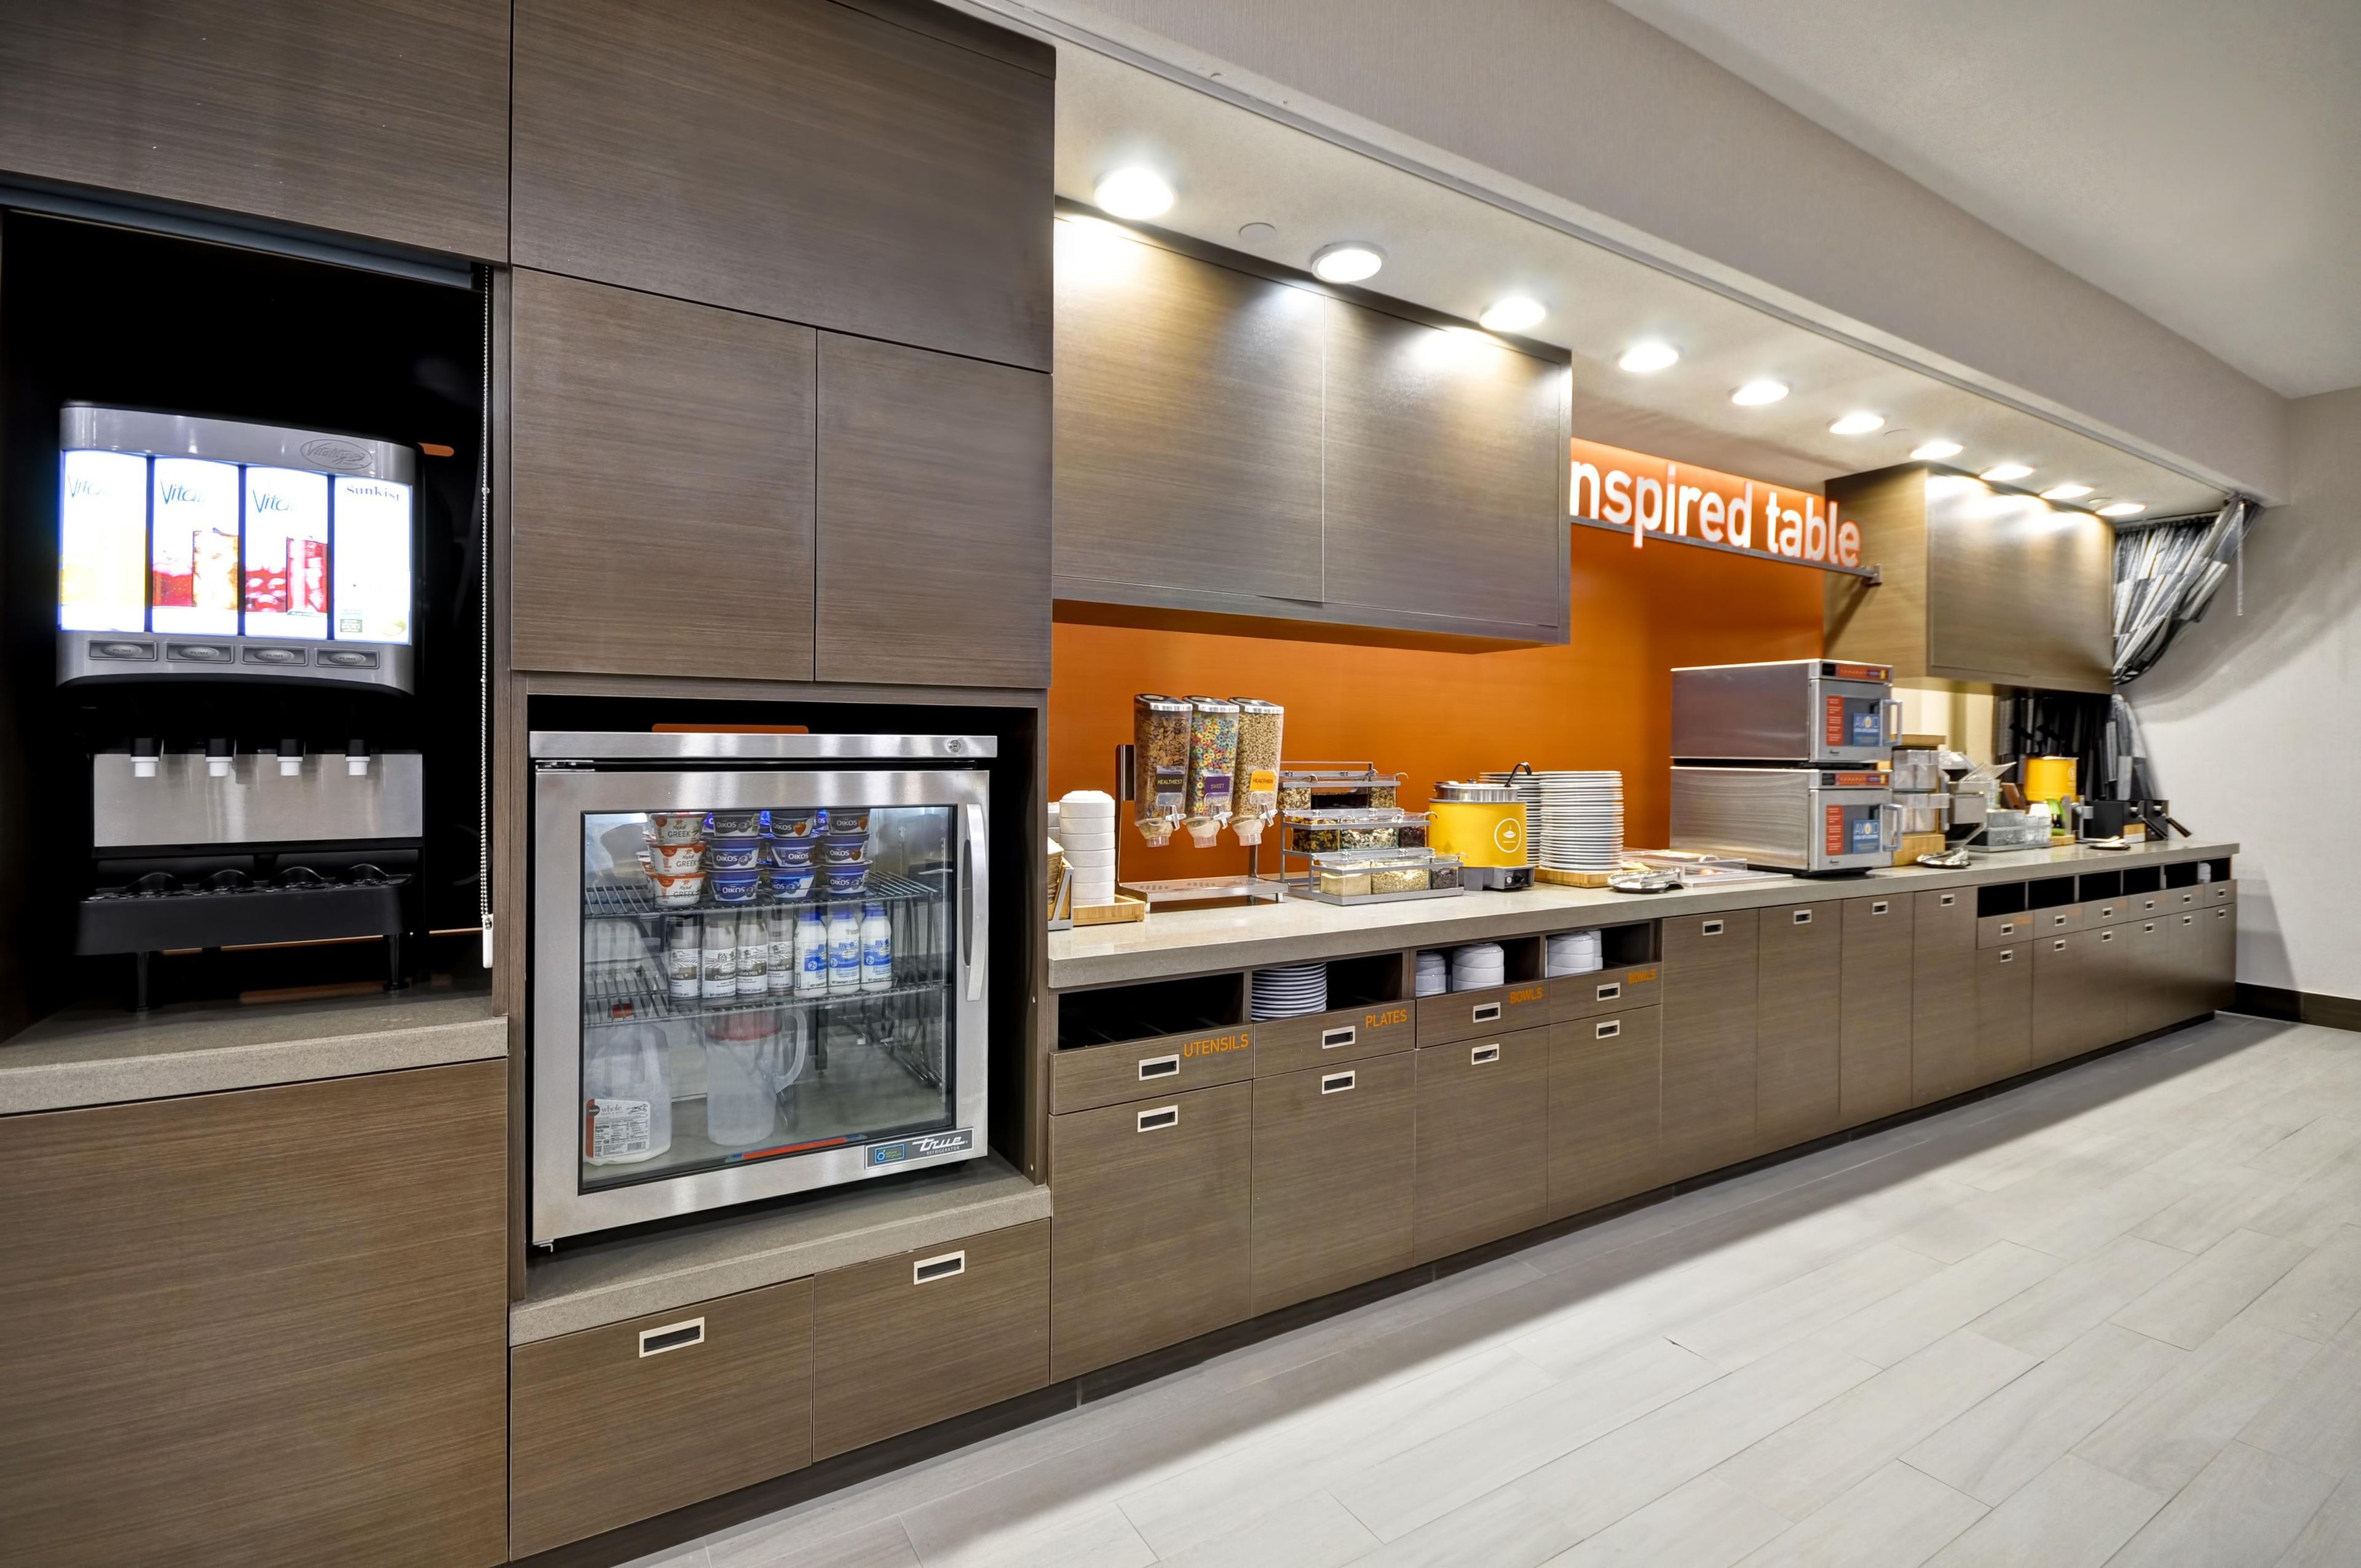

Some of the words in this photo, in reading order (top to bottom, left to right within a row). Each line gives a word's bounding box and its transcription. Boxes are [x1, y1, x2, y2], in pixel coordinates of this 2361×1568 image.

[346, 485, 400, 501] Sunkist
[1570, 462, 1754, 548] nspired
[1766, 491, 1861, 568] table
[1627, 968, 1657, 984] BOWLS
[1510, 987, 1543, 1004] BOWLS
[1366, 1008, 1408, 1028] PLATES
[1184, 1033, 1249, 1058] UTENSILS
[926, 1145, 960, 1156] REFRIGERATOR
